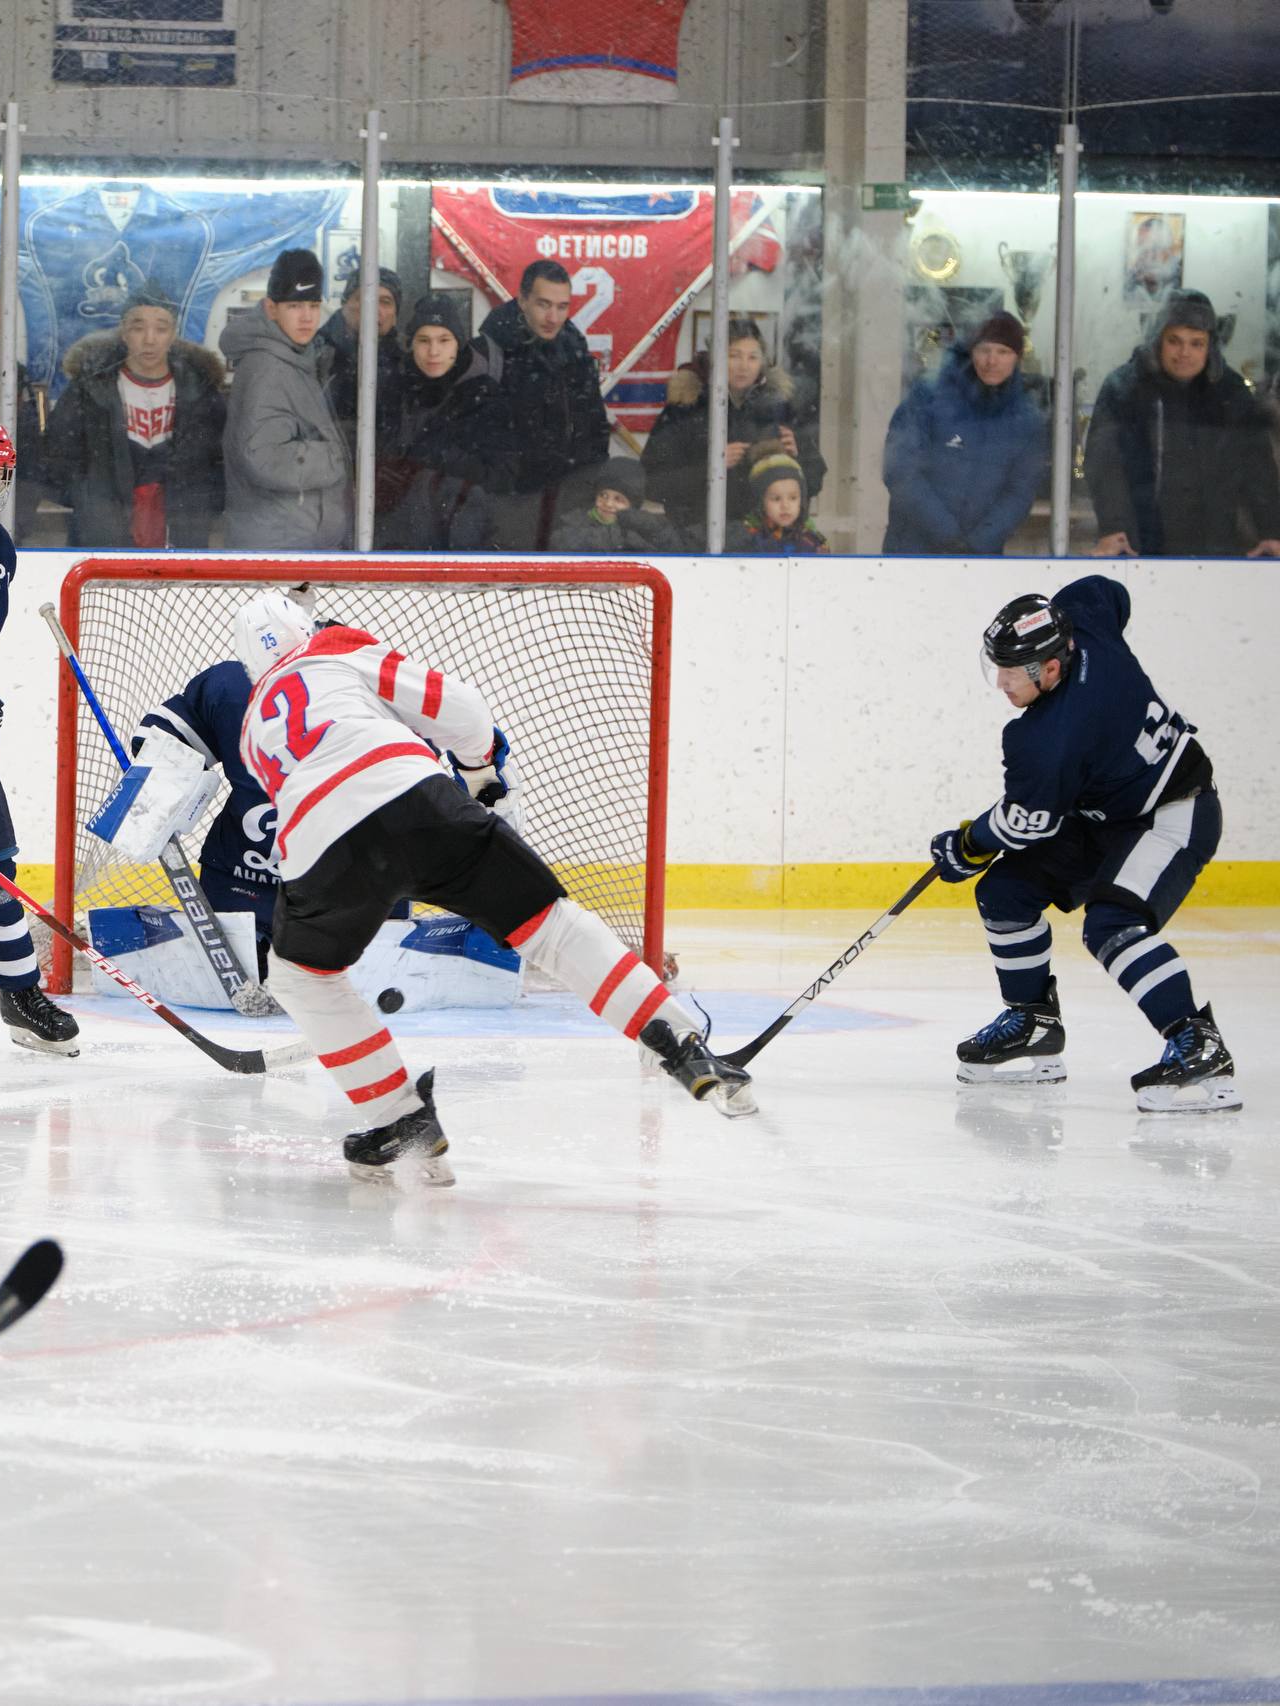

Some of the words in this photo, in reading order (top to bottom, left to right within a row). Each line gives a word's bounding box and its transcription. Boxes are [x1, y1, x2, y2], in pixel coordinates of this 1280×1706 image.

[536, 234, 649, 259] ФЕТИСОВ
[570, 266, 616, 354] 2
[261, 632, 278, 650] 25
[1006, 803, 1051, 832] 69
[173, 876, 246, 999] BAUER
[802, 930, 878, 1001] VAPOR
